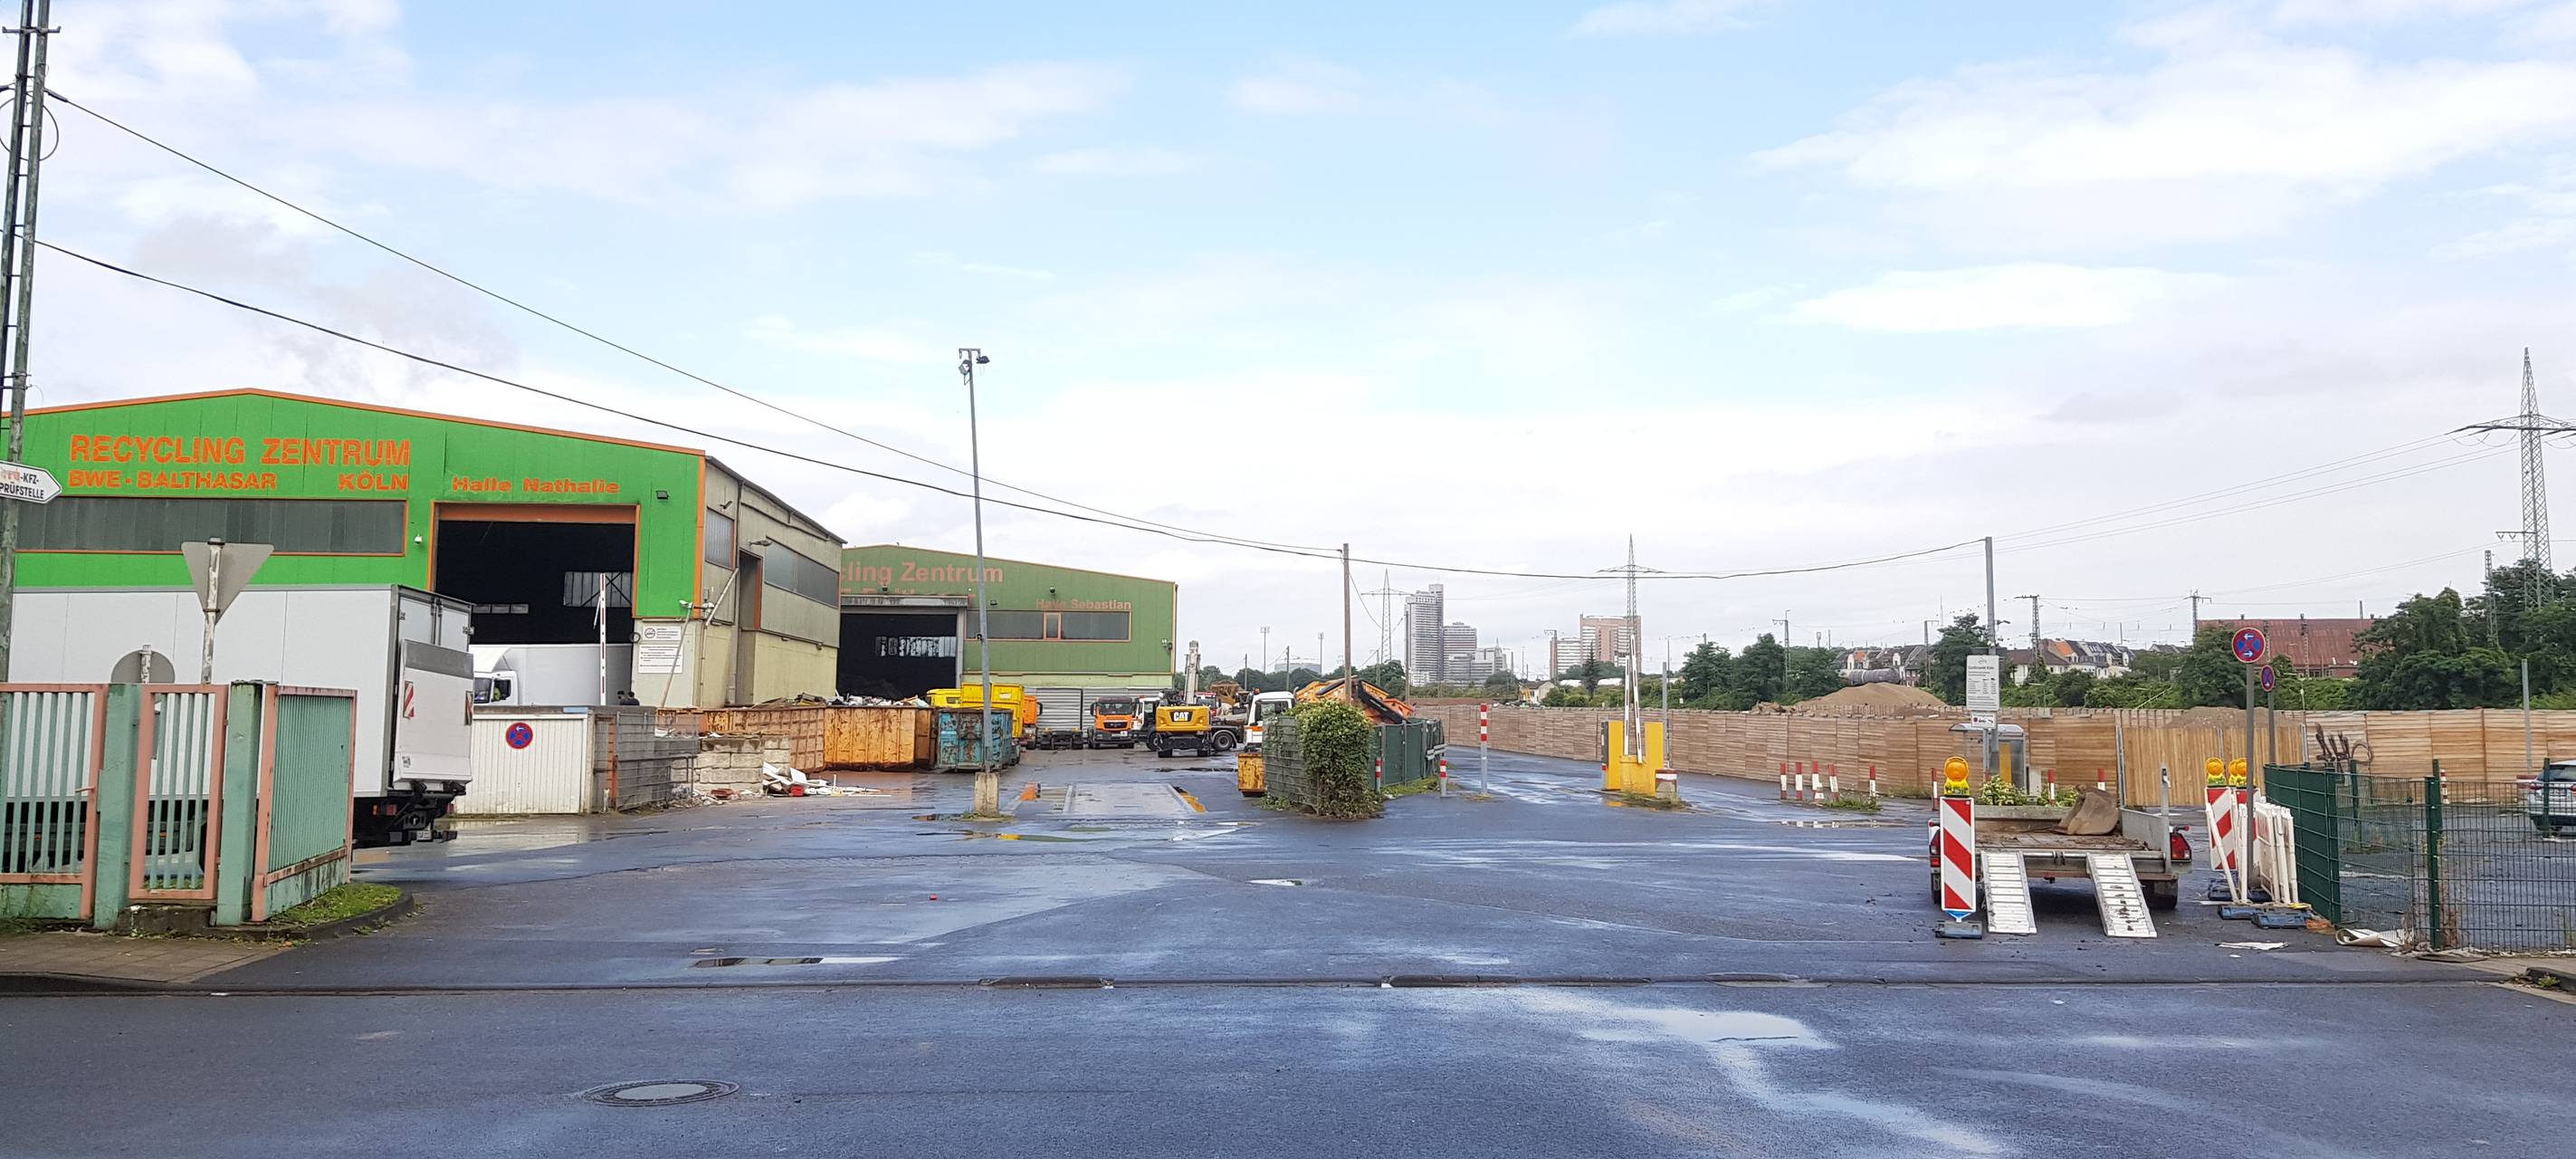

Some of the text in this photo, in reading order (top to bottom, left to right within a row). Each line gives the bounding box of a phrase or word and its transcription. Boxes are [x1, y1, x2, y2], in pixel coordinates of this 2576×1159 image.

[70, 435, 410, 466] RECYCLING ZENTRUM
[68, 469, 121, 488] BWE
[137, 471, 276, 490] BALTHASAR
[338, 470, 409, 491] KÖLN
[453, 476, 620, 493] Halle Nathalie
[0, 481, 44, 499] PRÜFSTELLE
[900, 561, 1003, 583] Zentrum
[1071, 598, 1131, 610] Sebastian
[1173, 711, 1189, 722] CAT
